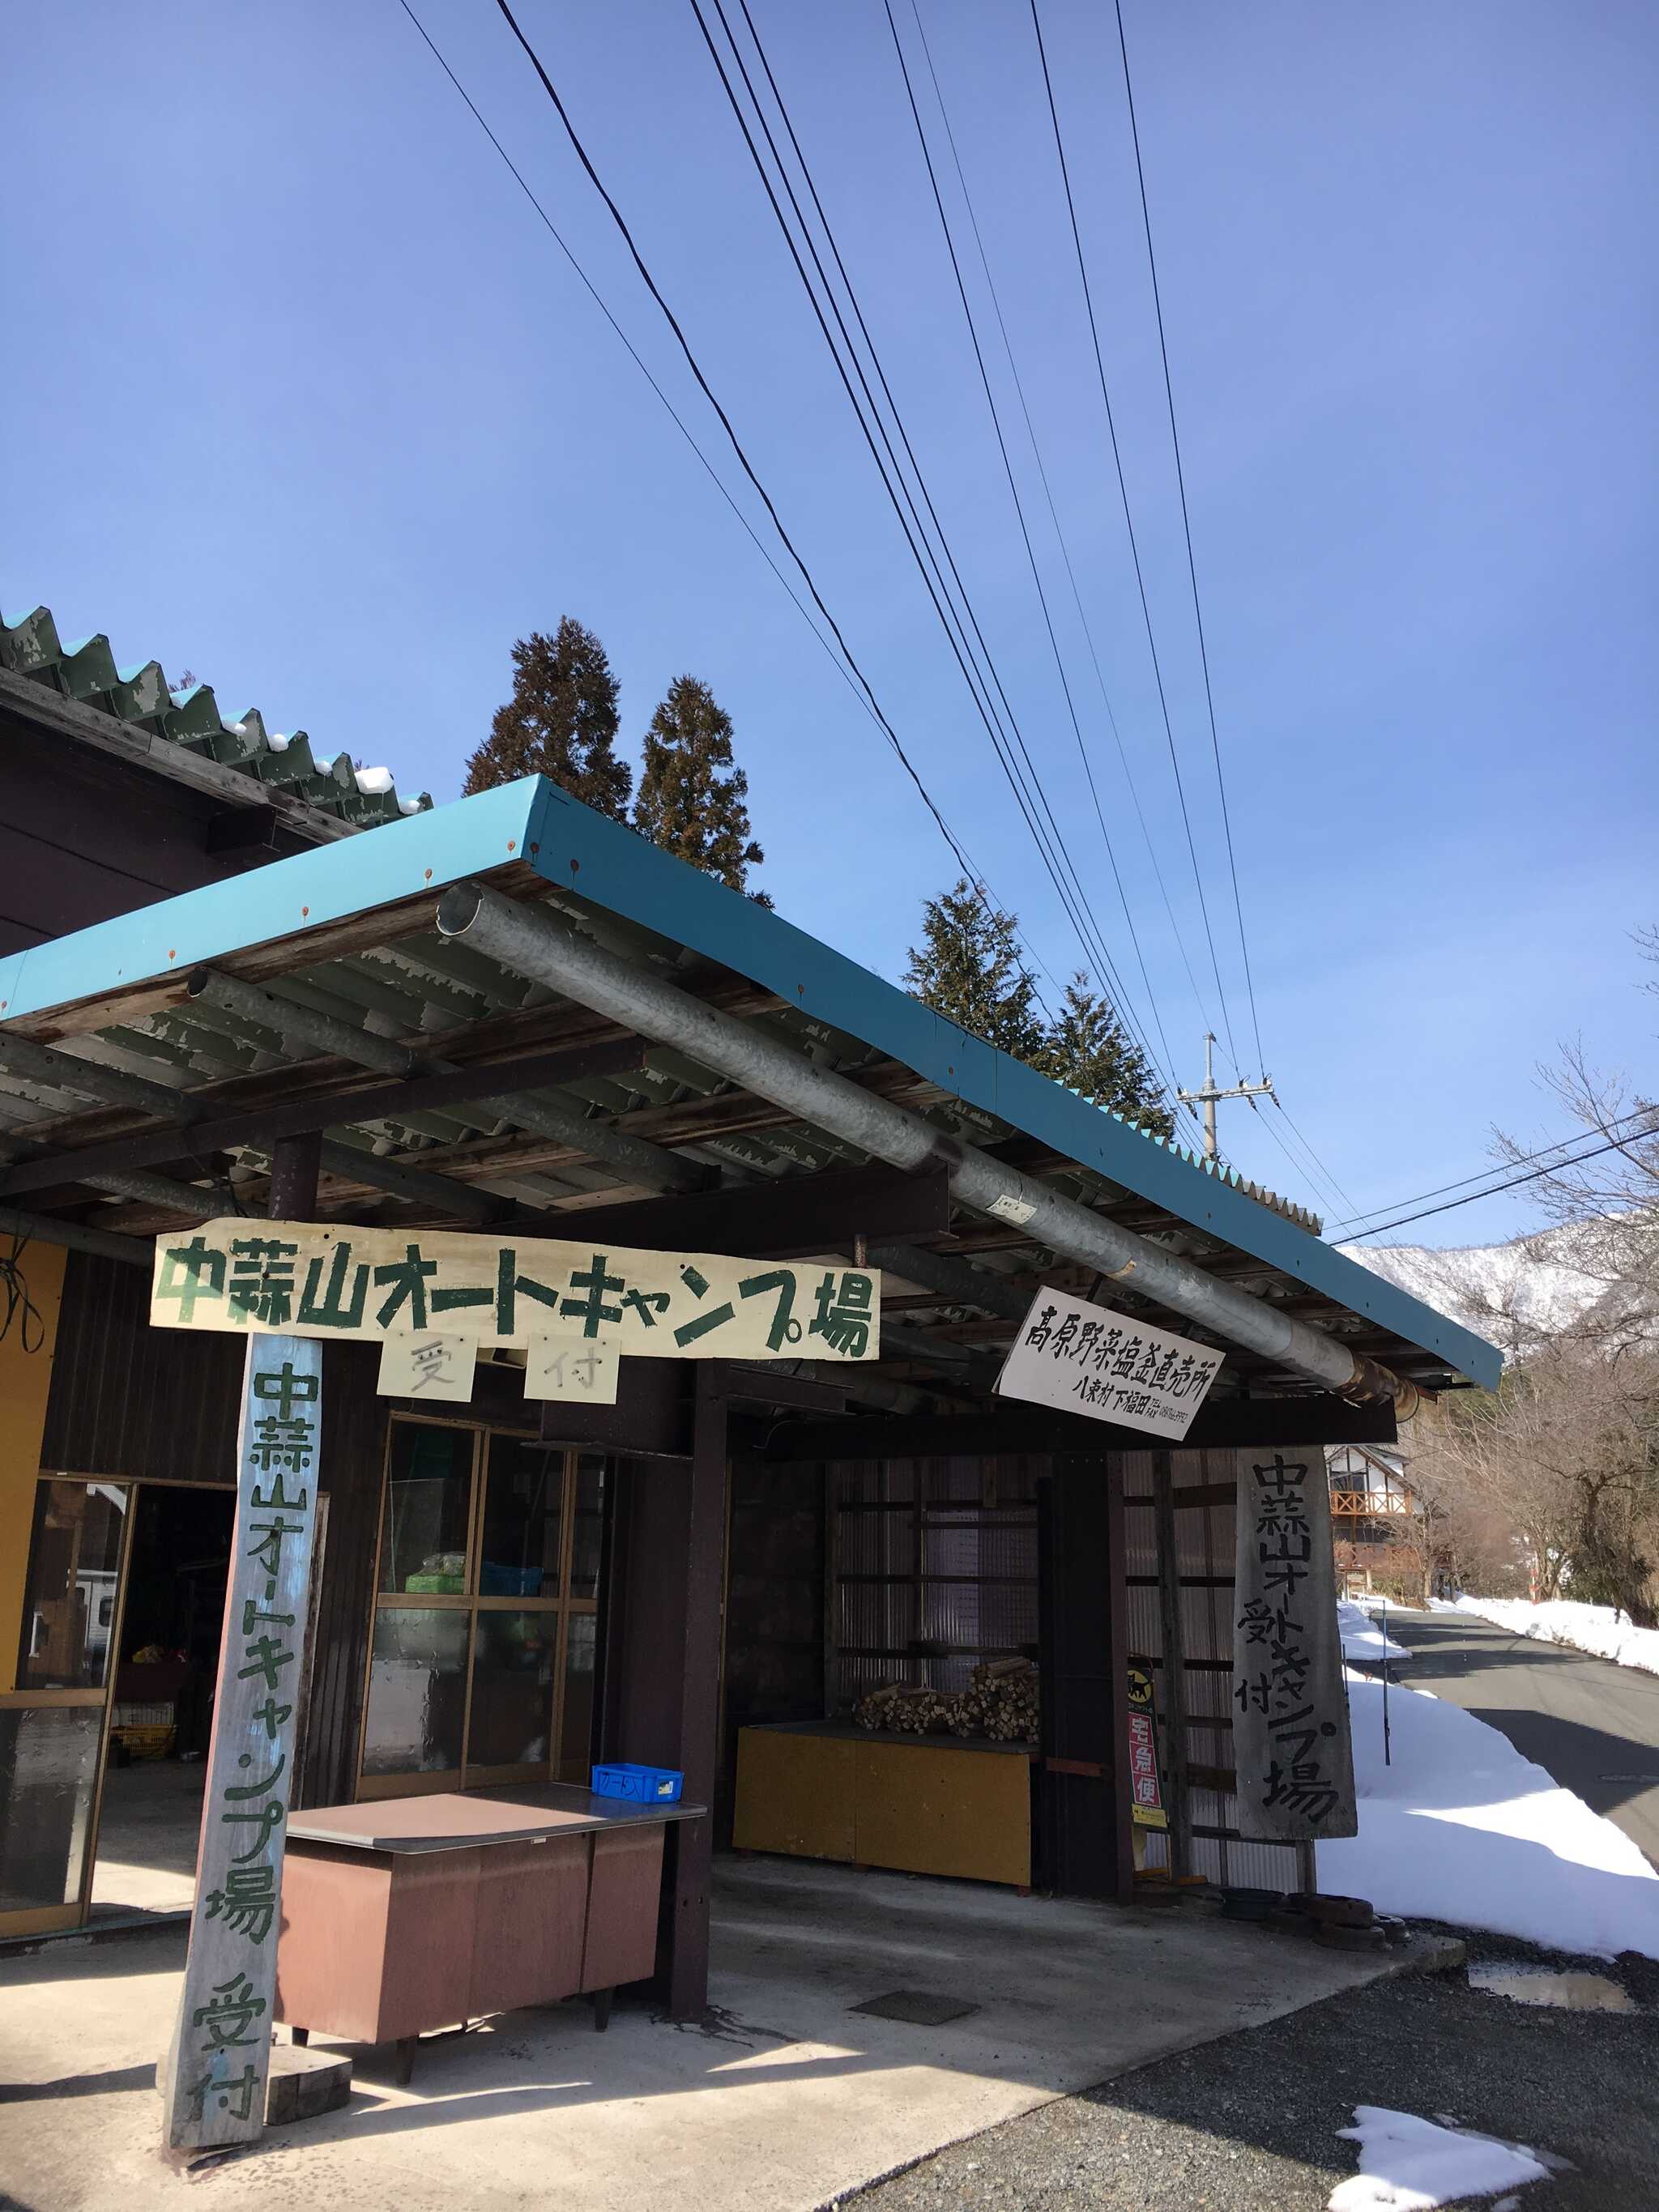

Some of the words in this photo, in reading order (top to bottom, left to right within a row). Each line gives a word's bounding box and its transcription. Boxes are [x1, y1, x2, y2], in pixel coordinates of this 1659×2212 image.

[159, 1236, 872, 1357] 中蒜山オートキャンプ場
[411, 1340, 455, 1392] 受
[544, 1346, 603, 1390] 付
[204, 1362, 319, 1944] 中蒜山オートキャンプ場
[1234, 1597, 1274, 1715] 受付
[1252, 1454, 1340, 1822] 中蒜山オートキャンプ場
[1131, 1716, 1156, 1803] 宅急便
[186, 1971, 267, 2122] 受付
